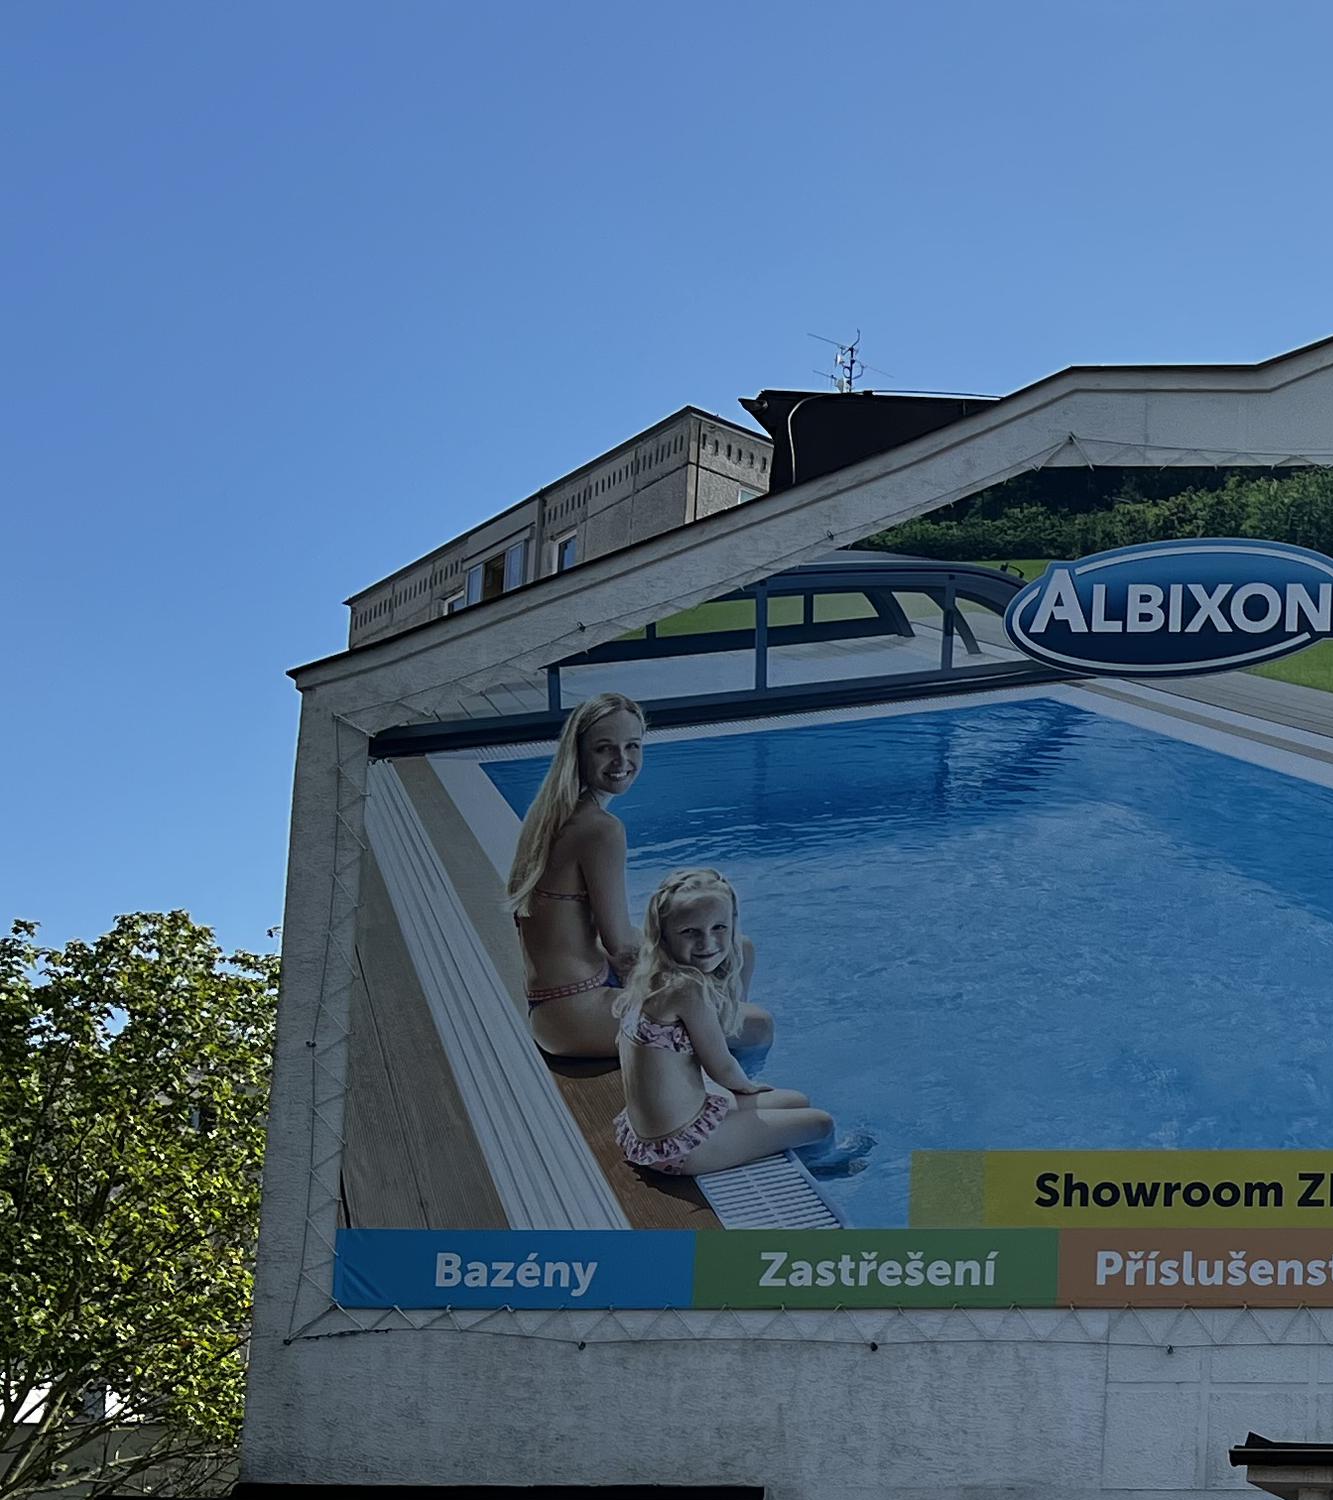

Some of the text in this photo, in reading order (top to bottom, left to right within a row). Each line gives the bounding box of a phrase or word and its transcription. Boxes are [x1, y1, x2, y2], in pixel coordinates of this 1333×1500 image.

[1029, 568, 1333, 633] ALBIXON
[1034, 1172, 1284, 1208] Showroom
[435, 1251, 598, 1297] Bazény
[759, 1251, 1000, 1287] Zastřešení
